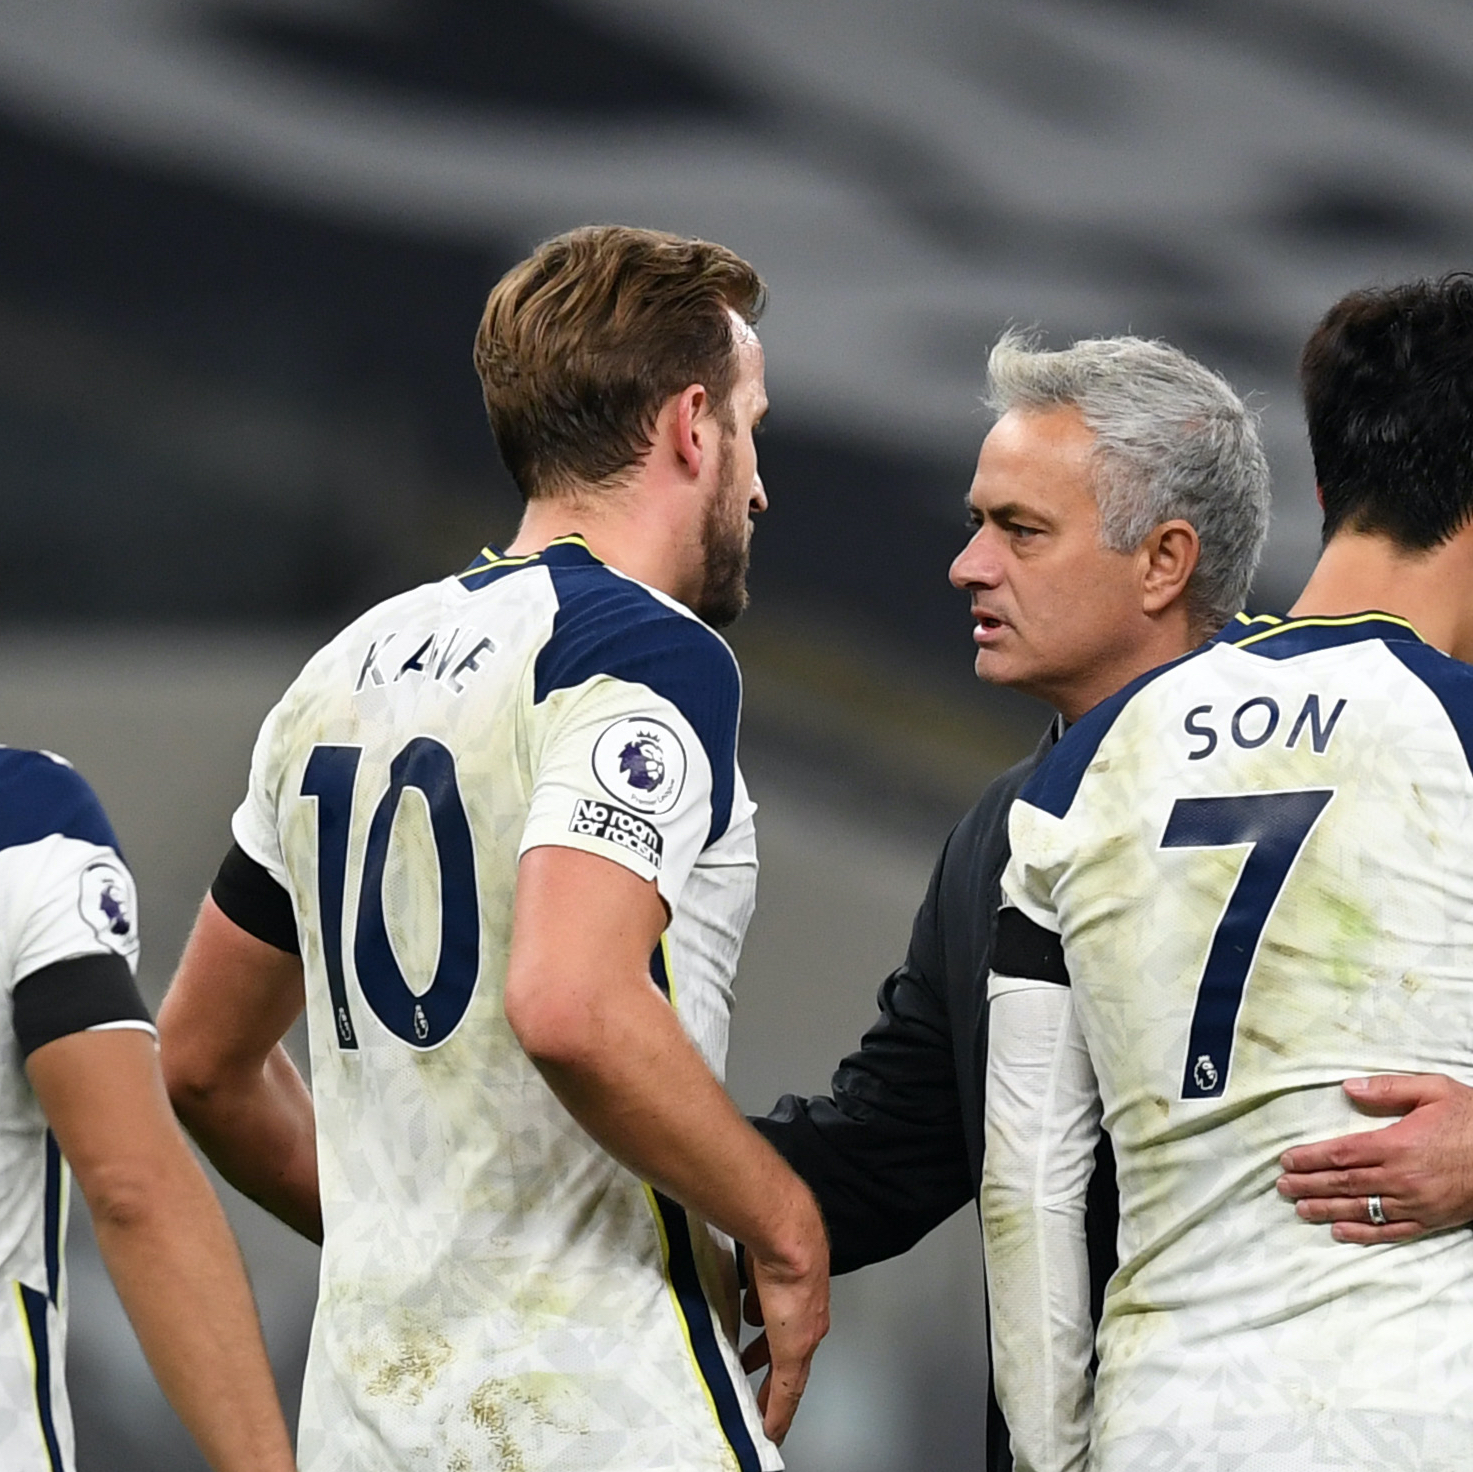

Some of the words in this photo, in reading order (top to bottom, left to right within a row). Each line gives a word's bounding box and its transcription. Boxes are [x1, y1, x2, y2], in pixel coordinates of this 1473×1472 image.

[1184, 694, 1347, 761] SON
[569, 815, 604, 836] for
[604, 825, 662, 870] racism
[574, 799, 609, 822] No
[609, 811, 658, 850] room
[300, 736, 481, 1052] 10
[1156, 788, 1338, 1102] 7
